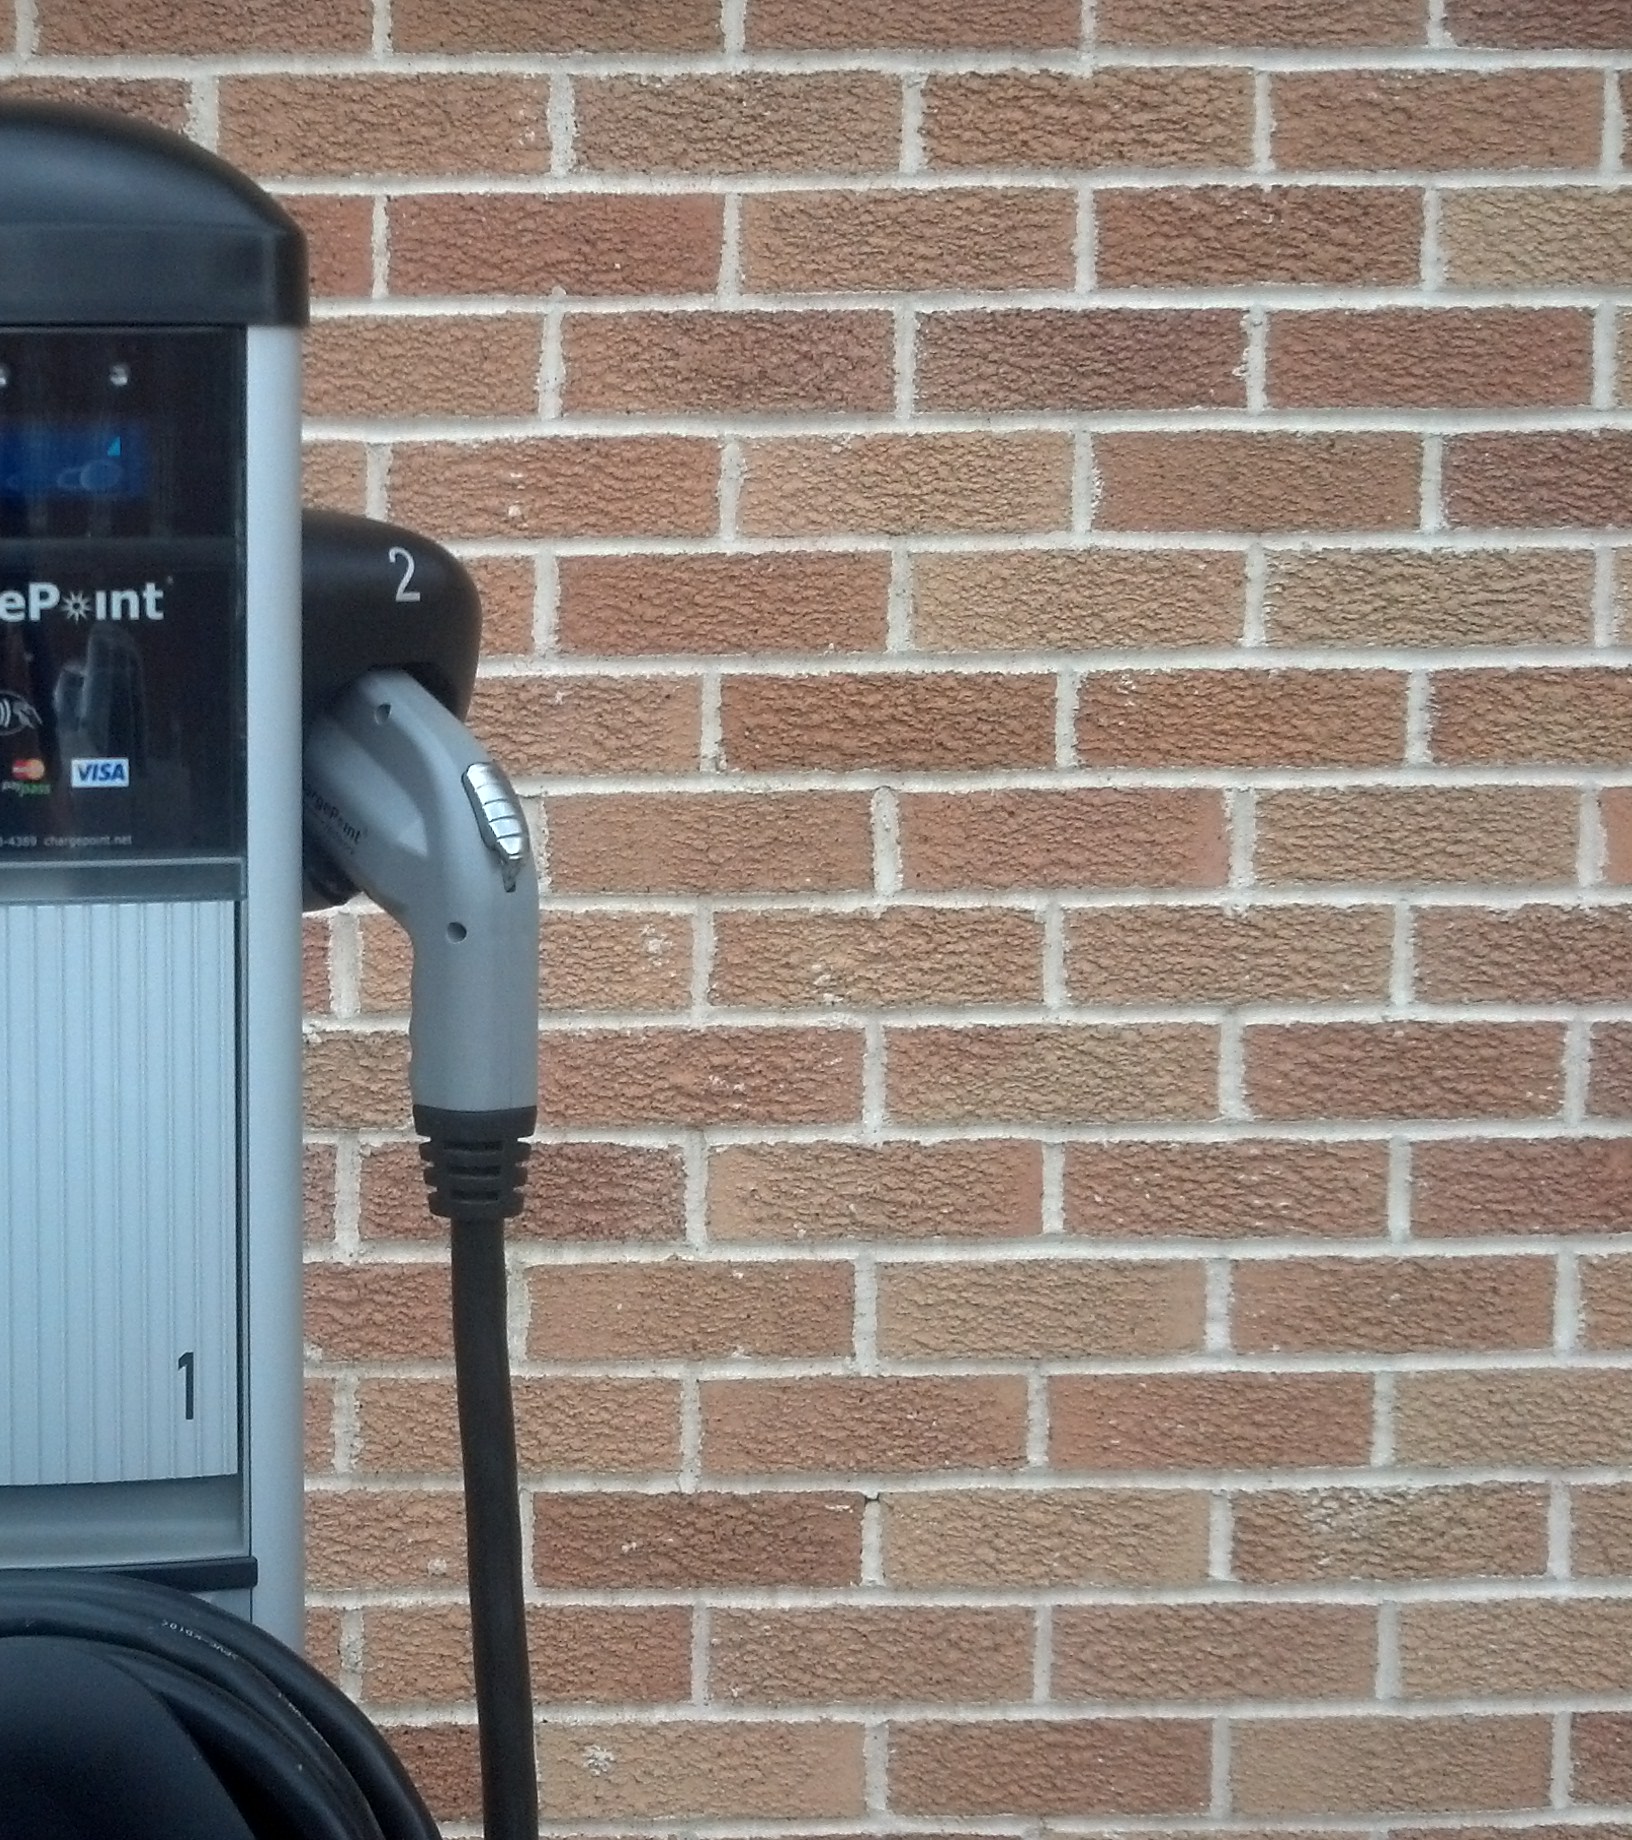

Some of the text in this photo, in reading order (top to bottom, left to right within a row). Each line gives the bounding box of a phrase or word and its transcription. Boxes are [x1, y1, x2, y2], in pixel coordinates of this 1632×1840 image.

[389, 546, 421, 602] 2
[77, 762, 126, 782] VISA
[177, 1351, 194, 1420] 1
